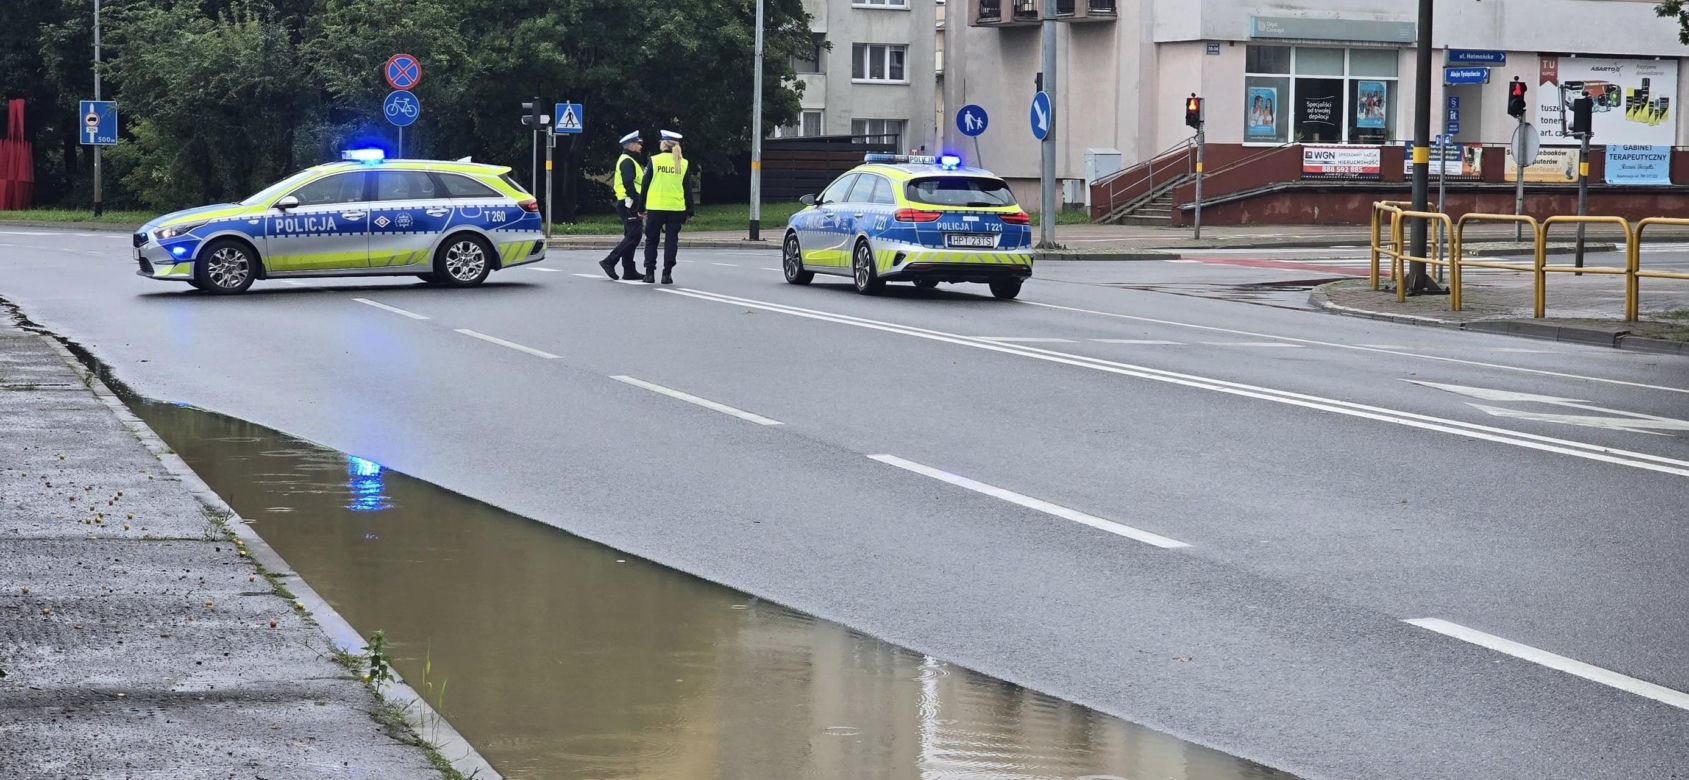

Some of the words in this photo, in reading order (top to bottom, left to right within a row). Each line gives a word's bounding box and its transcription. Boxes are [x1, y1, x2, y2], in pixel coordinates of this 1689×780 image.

[1541, 104, 1561, 112] tusze
[909, 155, 935, 164] POLICJA
[1314, 151, 1336, 160] WGN
[1609, 153, 1667, 161] TERAPEUTYCZNY
[657, 165, 681, 175] POLIC
[484, 210, 490, 222] T
[491, 210, 506, 223] 260
[275, 216, 337, 233] POLICJA
[937, 222, 970, 231] POLICJA
[984, 222, 990, 231] T
[991, 223, 1003, 232] 221
[953, 236, 968, 245] HPT
